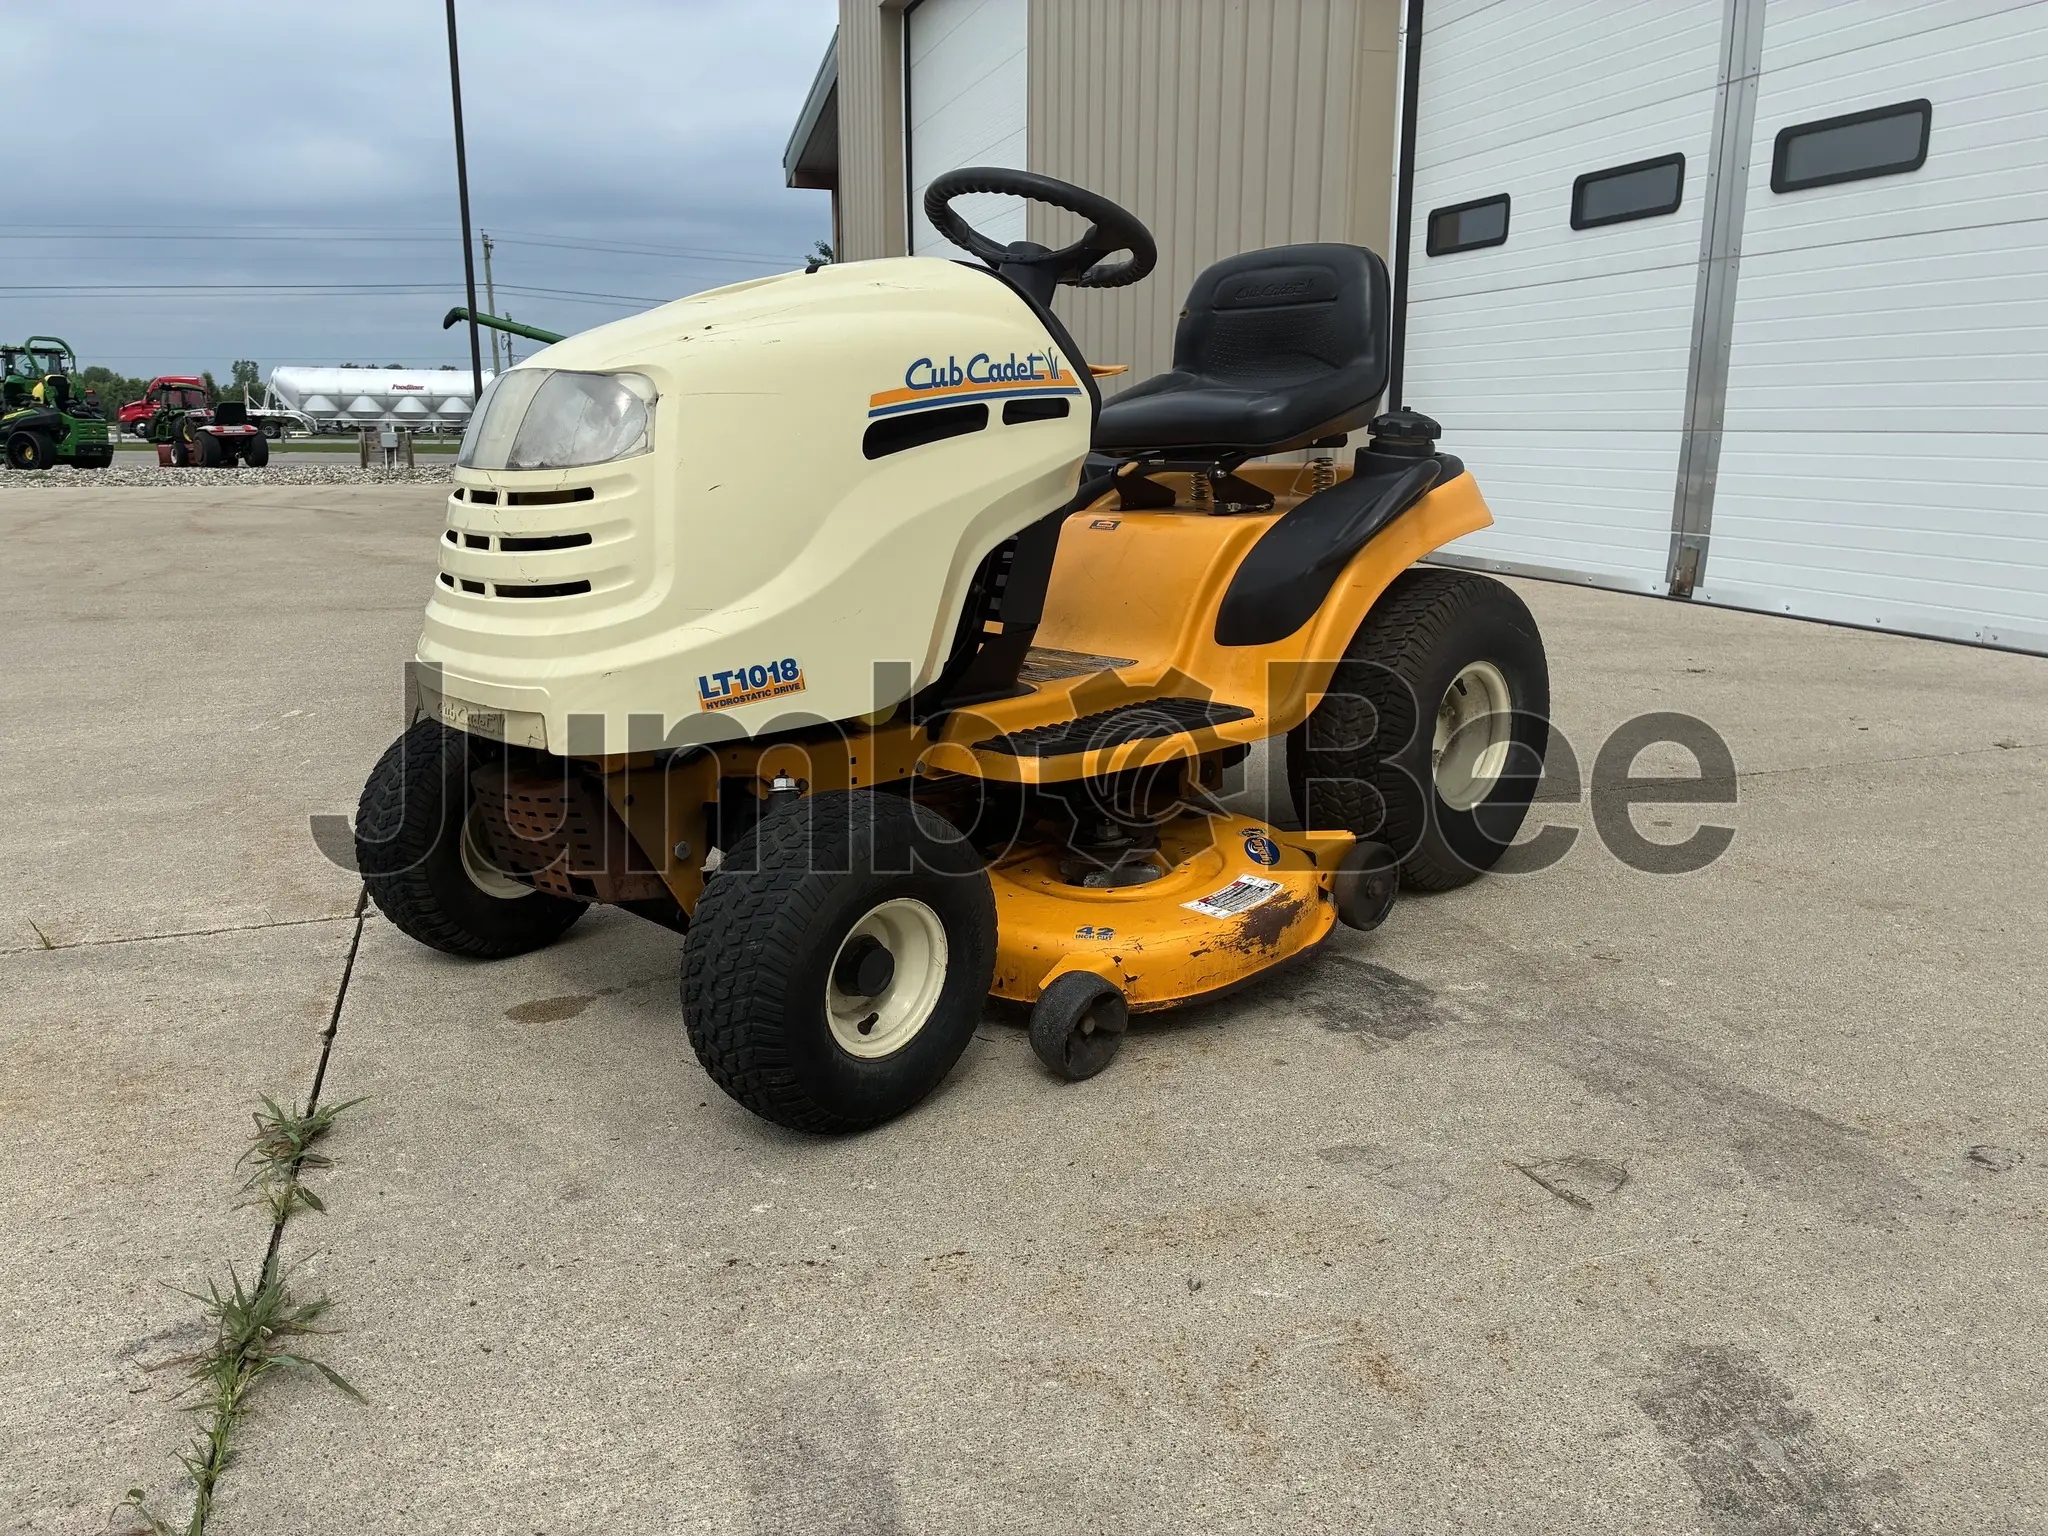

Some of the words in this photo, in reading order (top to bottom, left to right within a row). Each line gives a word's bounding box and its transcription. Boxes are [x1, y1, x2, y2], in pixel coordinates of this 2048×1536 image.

[905, 356, 963, 390] Cub
[966, 352, 1045, 384] Cadet
[698, 658, 800, 700] LT1018
[706, 689, 772, 710] HYDROSTATIC
[773, 682, 801, 696] DRIVE
[1076, 926, 1115, 936] 42
